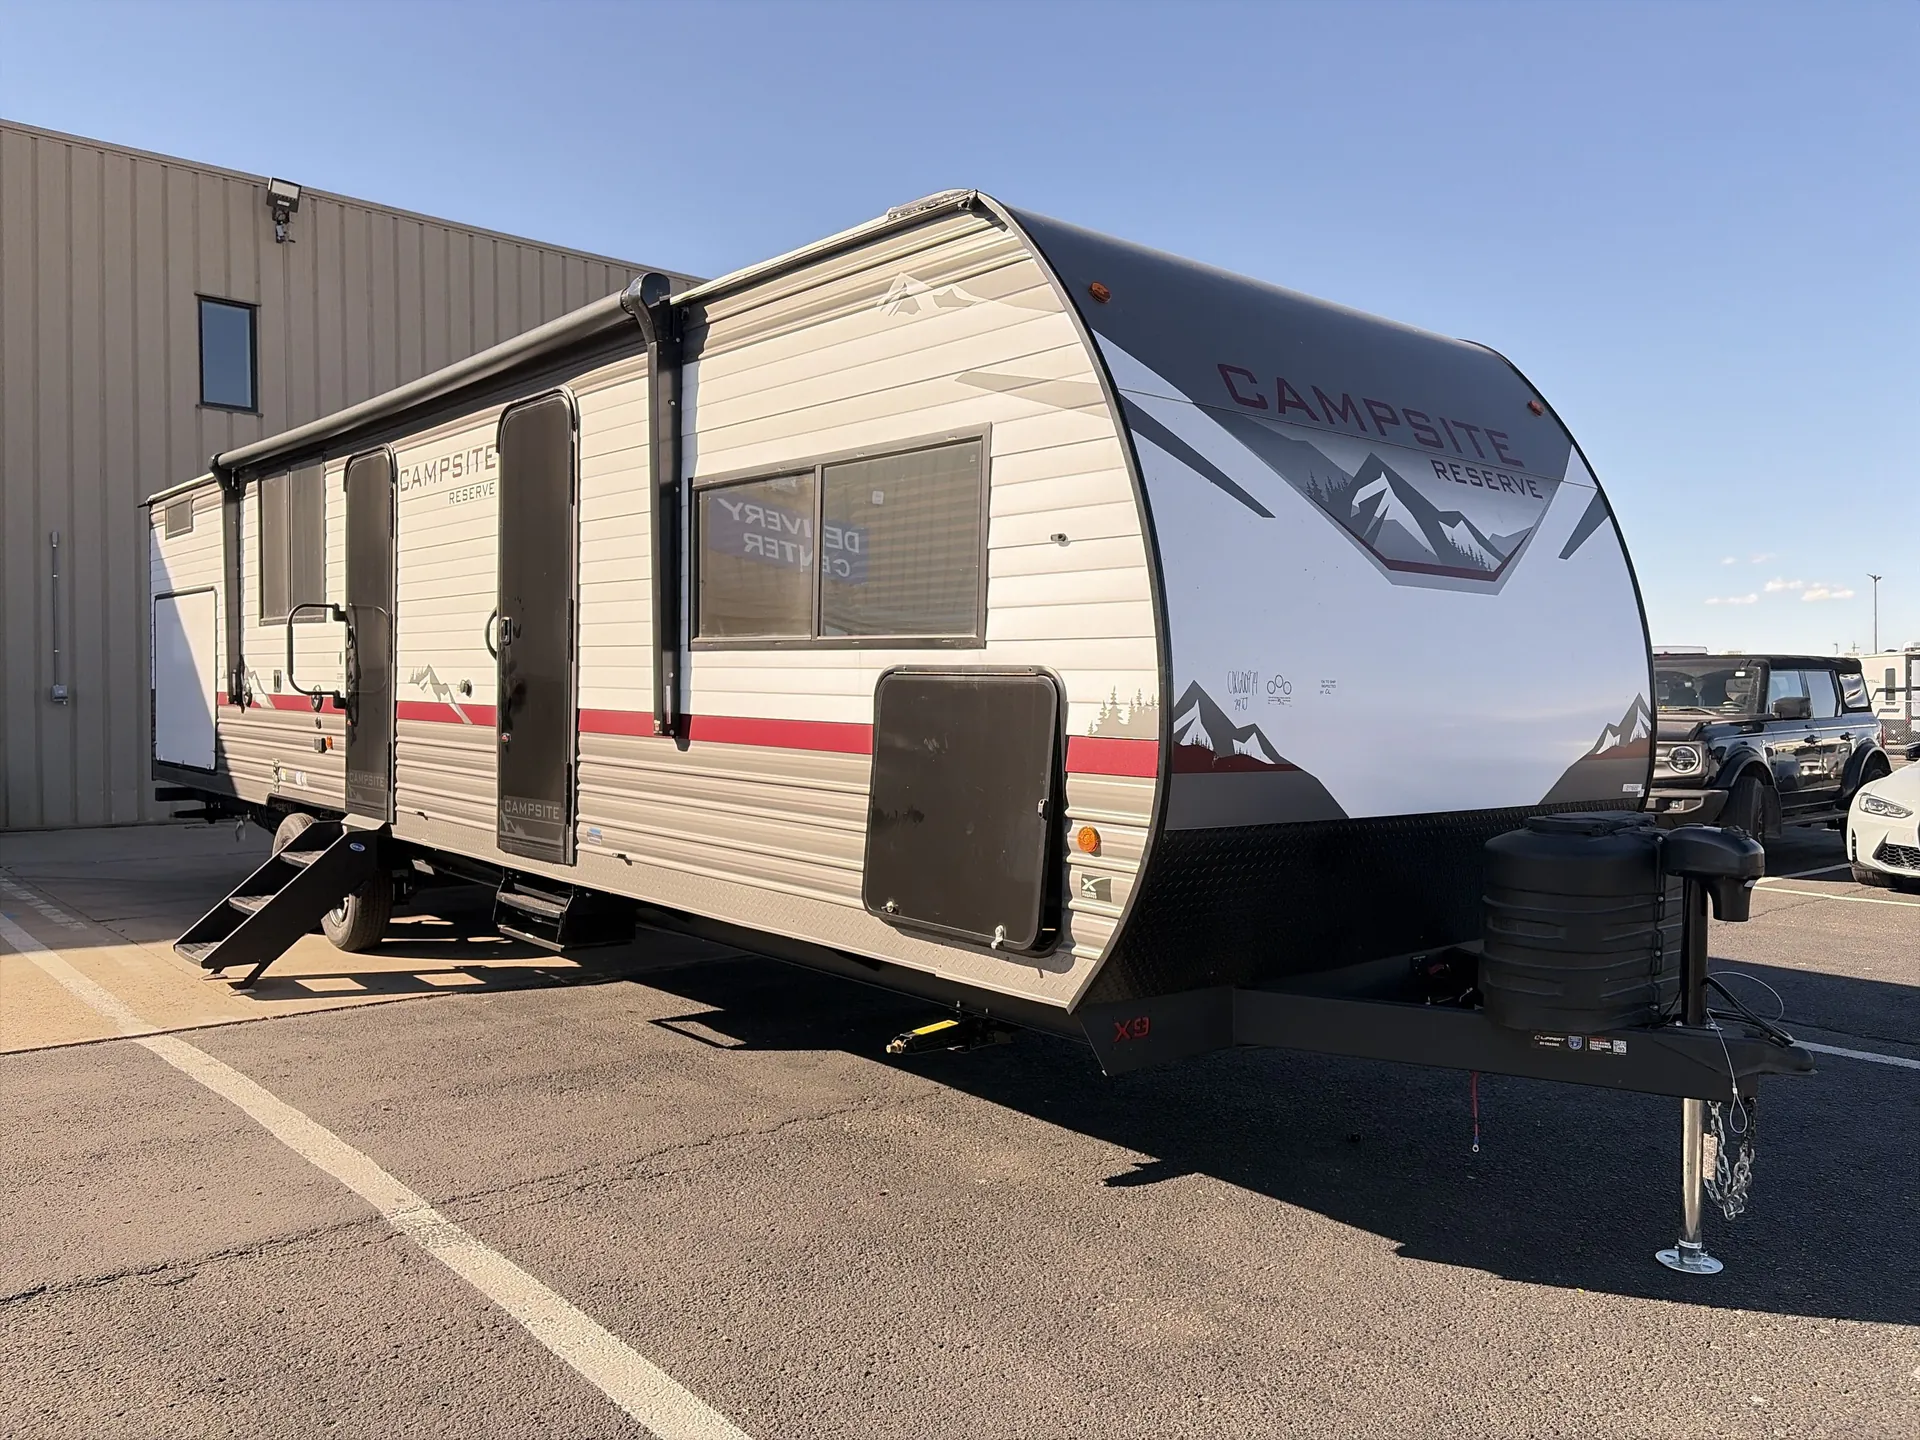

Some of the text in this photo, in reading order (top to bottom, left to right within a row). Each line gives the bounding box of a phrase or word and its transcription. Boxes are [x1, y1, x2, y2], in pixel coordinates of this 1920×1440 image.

[1217, 363, 1525, 468] CAMPSITE
[400, 443, 496, 492] CAMPSITE
[1430, 459, 1544, 499] RESERVE
[449, 482, 495, 504] RESERVE
[350, 772, 385, 787] CAMPSITE
[504, 800, 560, 820] CAMPSITE
